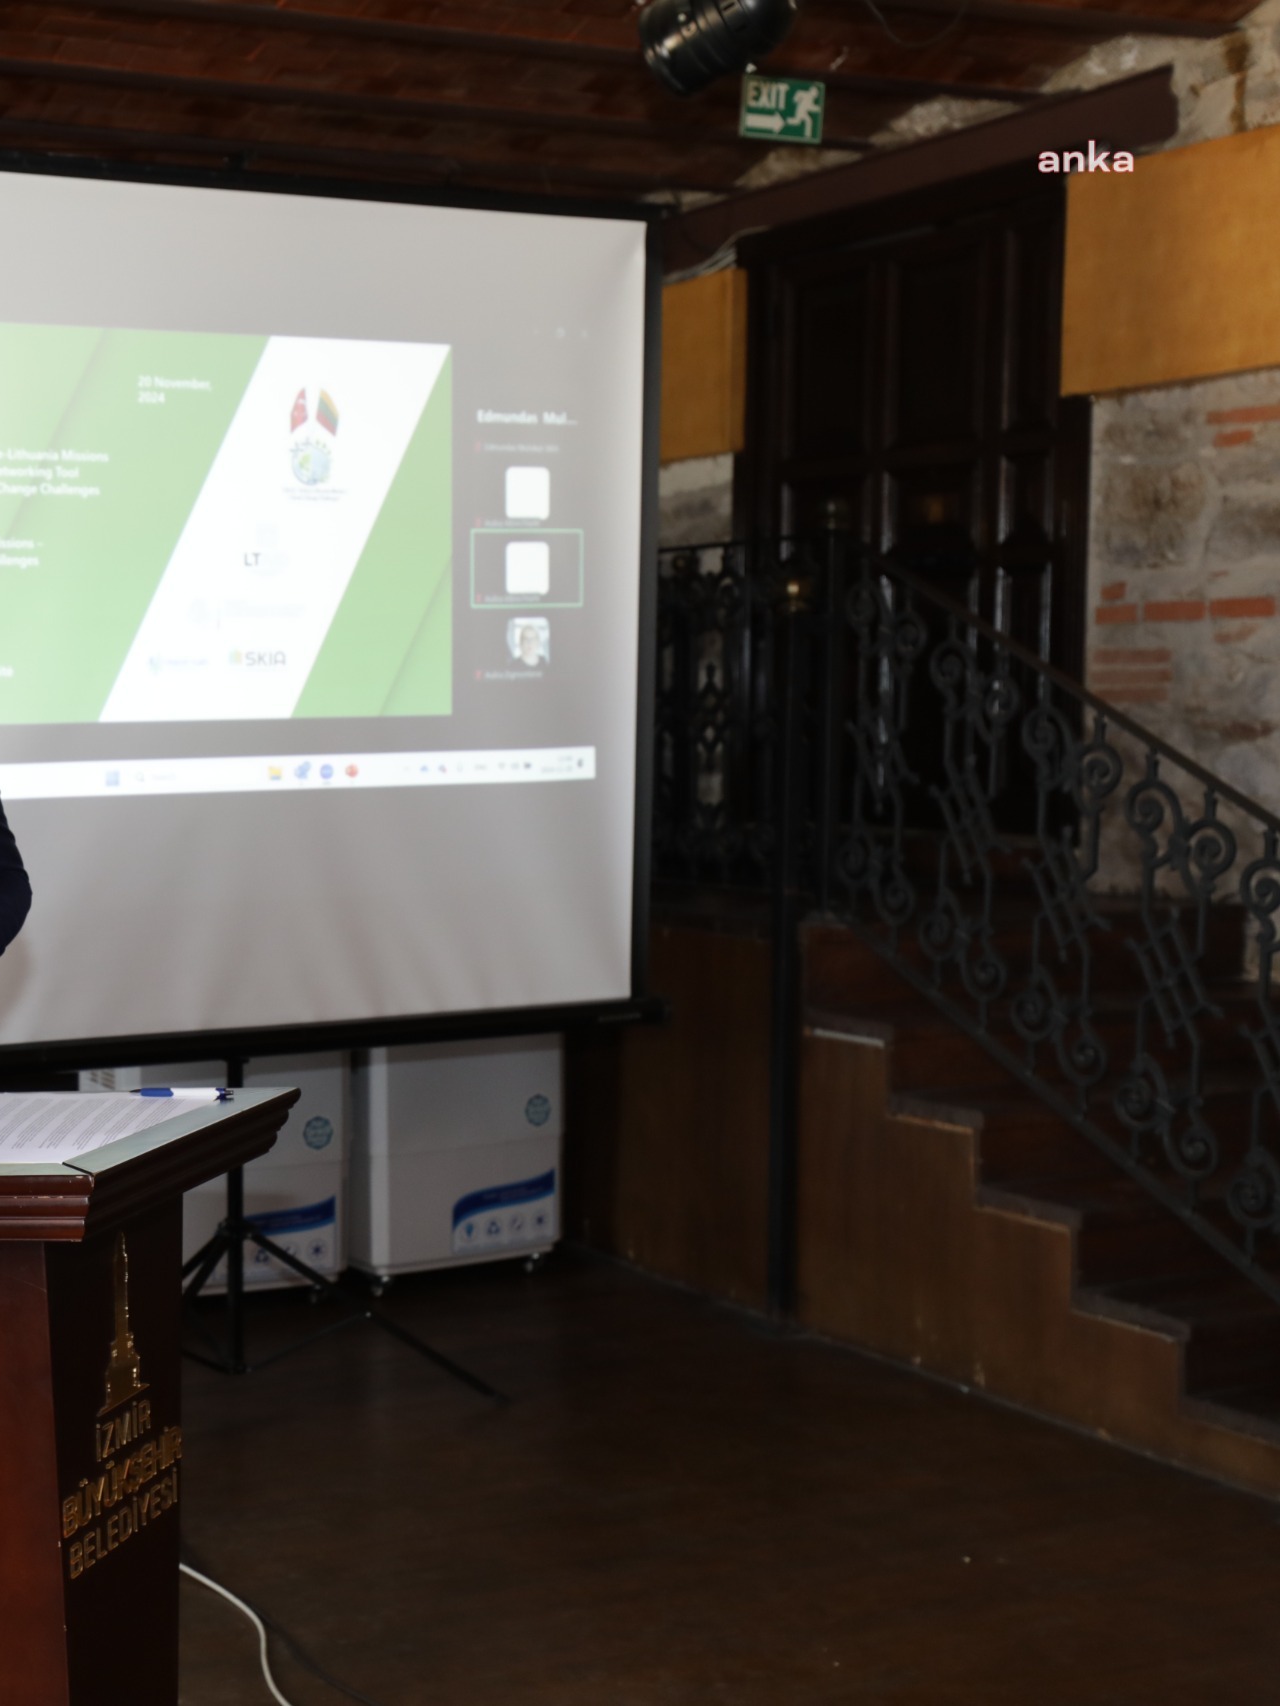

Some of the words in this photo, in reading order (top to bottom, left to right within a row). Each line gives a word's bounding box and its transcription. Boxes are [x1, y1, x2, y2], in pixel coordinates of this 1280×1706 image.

[747, 81, 789, 110] EXIT
[61, 448, 109, 462] Missions
[55, 466, 80, 478] Tool
[40, 483, 100, 498] Challenges
[245, 651, 286, 666] SKIA
[70, 1467, 178, 1580] BELEDİYESİ
